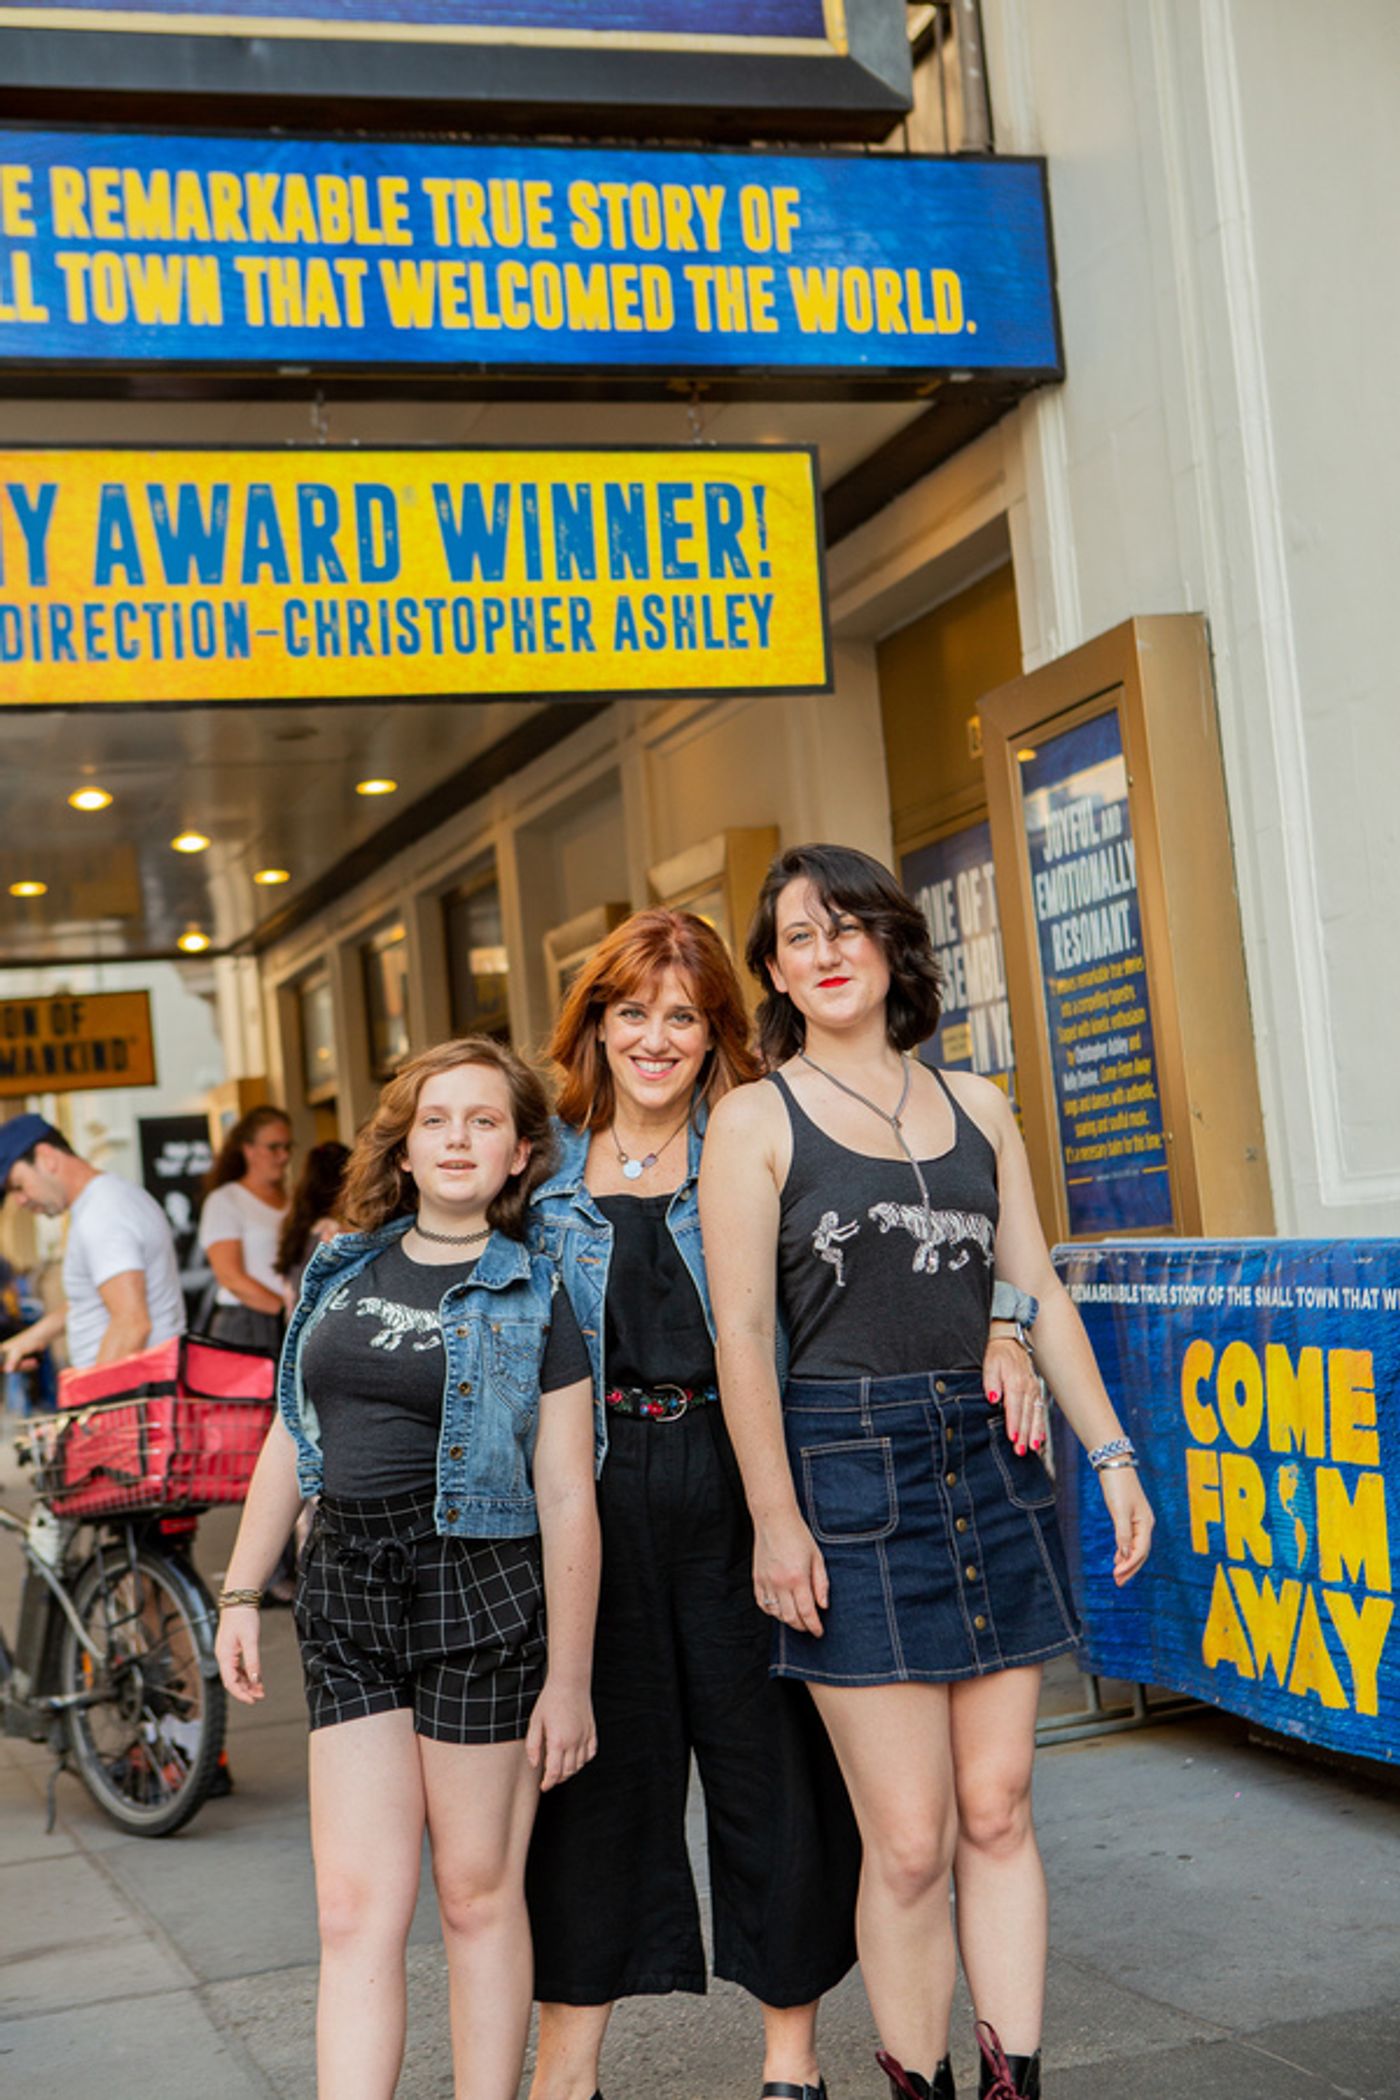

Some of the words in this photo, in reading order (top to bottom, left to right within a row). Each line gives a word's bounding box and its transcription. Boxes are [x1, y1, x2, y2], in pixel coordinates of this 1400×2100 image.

[50, 167, 412, 246] REMARKABLE
[422, 178, 557, 249] TRUE
[569, 181, 726, 252] STORY
[740, 184, 801, 254] OF
[56, 252, 221, 326] TOWN
[234, 257, 368, 328] THAT
[378, 260, 675, 332] WELCOMED
[683, 264, 779, 333] THE
[787, 267, 978, 336] WORLD.
[93, 482, 402, 586] AWARD
[430, 482, 772, 584] WINNER!
[613, 593, 775, 653] ASHLEY
[1043, 798, 1100, 863] JOYFUL
[956, 866, 982, 936] OF
[1034, 838, 1138, 922] EMOTIONALLY
[1051, 899, 1138, 973] RESONANT.
[1169, 1284, 1205, 1306] STORY
[1207, 1285, 1225, 1307] OF
[1226, 1286, 1252, 1307] THE
[1254, 1286, 1295, 1308] SMALL
[1295, 1287, 1340, 1310] TOWN
[1341, 1287, 1380, 1311] THAT
[1180, 1338, 1382, 1466] COME
[1201, 1561, 1396, 1718] AWAY
